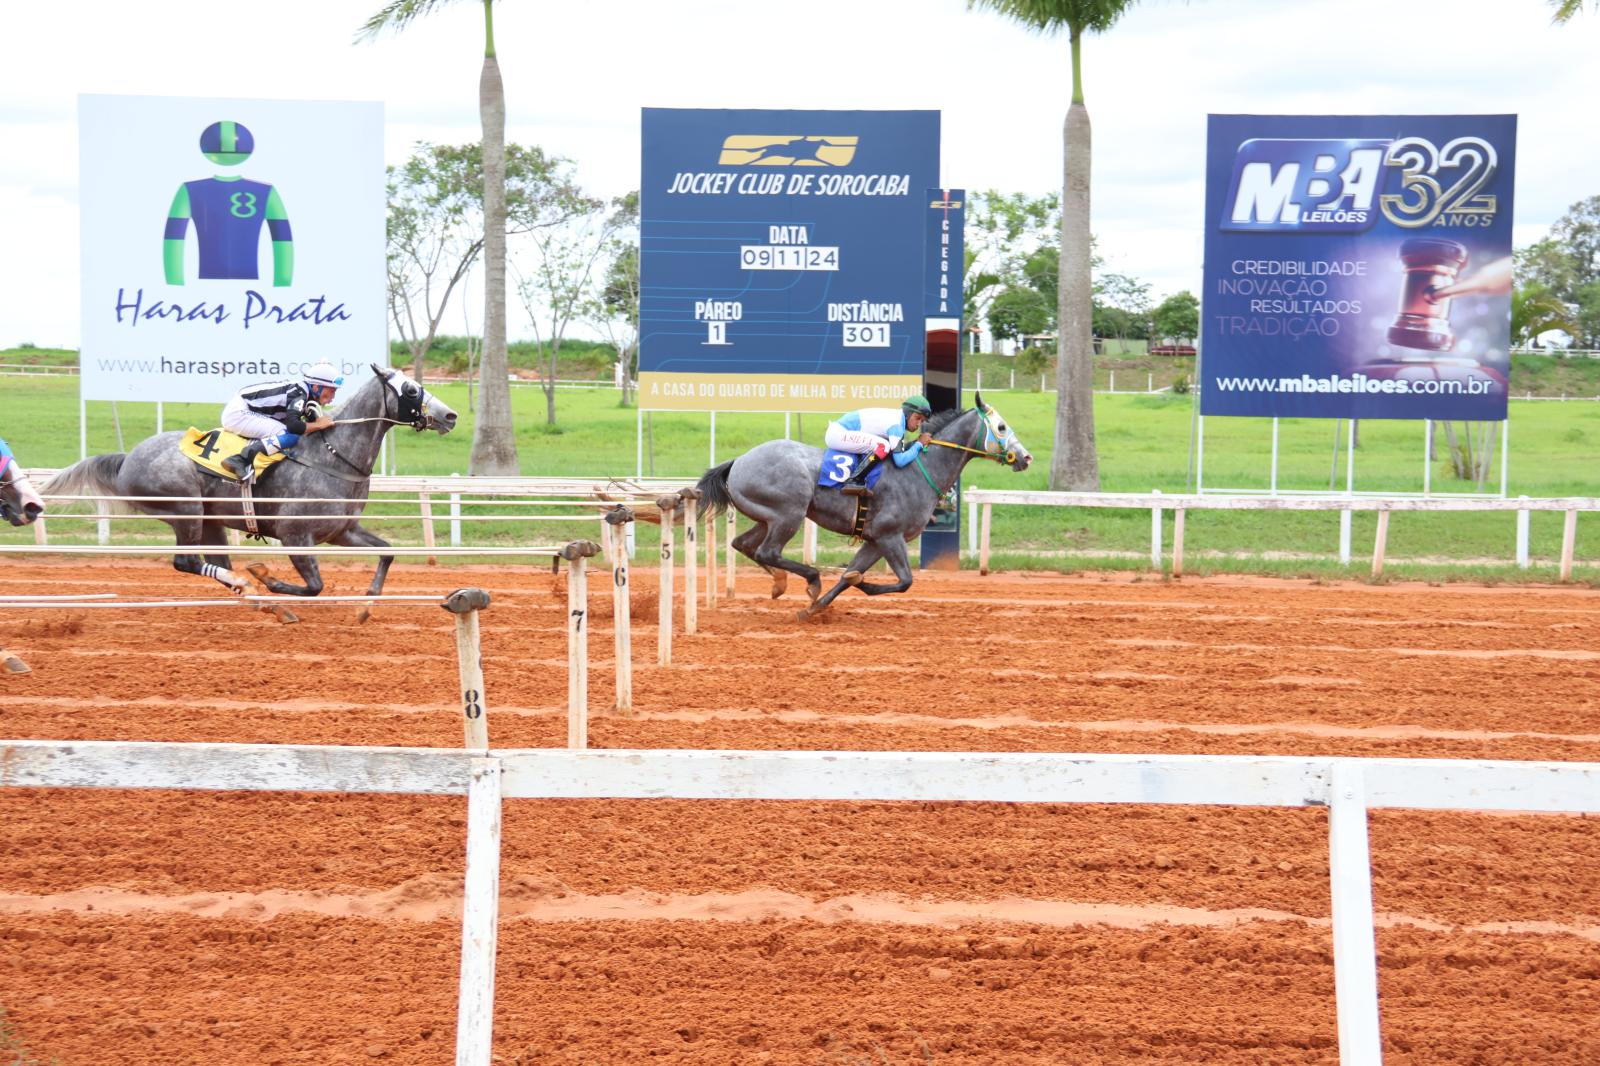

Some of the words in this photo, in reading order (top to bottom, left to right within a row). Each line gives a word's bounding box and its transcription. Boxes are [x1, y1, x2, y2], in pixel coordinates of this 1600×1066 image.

[667, 172, 738, 194] JOCKEY
[738, 173, 783, 195] CLUB
[787, 174, 815, 195] DE
[815, 174, 911, 196] SOROCABA
[1231, 147, 1383, 224] MBA
[1379, 136, 1498, 229] 32
[1302, 208, 1368, 224] LEILÕES
[1433, 213, 1494, 228] ANOS
[769, 225, 808, 245] DATA
[940, 219, 950, 313] CHEGADA
[1231, 260, 1369, 276] CREDIBILIDADE
[1217, 275, 1328, 299] INOVAÇÃO
[115, 288, 231, 327] Haras
[243, 289, 352, 330] Prata
[695, 298, 743, 320] PÁREO
[828, 300, 904, 322] DISTÂNCIA
[1250, 299, 1362, 314] RESULTADOS
[713, 325, 721, 341] 1
[845, 326, 886, 343] 301
[1215, 313, 1340, 341] TRADIÇÃO
[97, 356, 364, 378] www.harasprata.cobr
[650, 383, 659, 395] A
[664, 383, 695, 396] CASA
[700, 383, 715, 396] DO
[719, 383, 766, 397] QUARTO
[770, 384, 785, 397] DE
[790, 384, 827, 397] MILHA
[831, 384, 846, 398] DE
[1216, 373, 1493, 395] www.mbaleiloes.com.br
[193, 429, 222, 460] 4
[829, 454, 854, 483] 3
[661, 543, 671, 560] 5
[615, 567, 626, 587] 6
[571, 609, 584, 633] 7
[465, 689, 481, 720] 8
